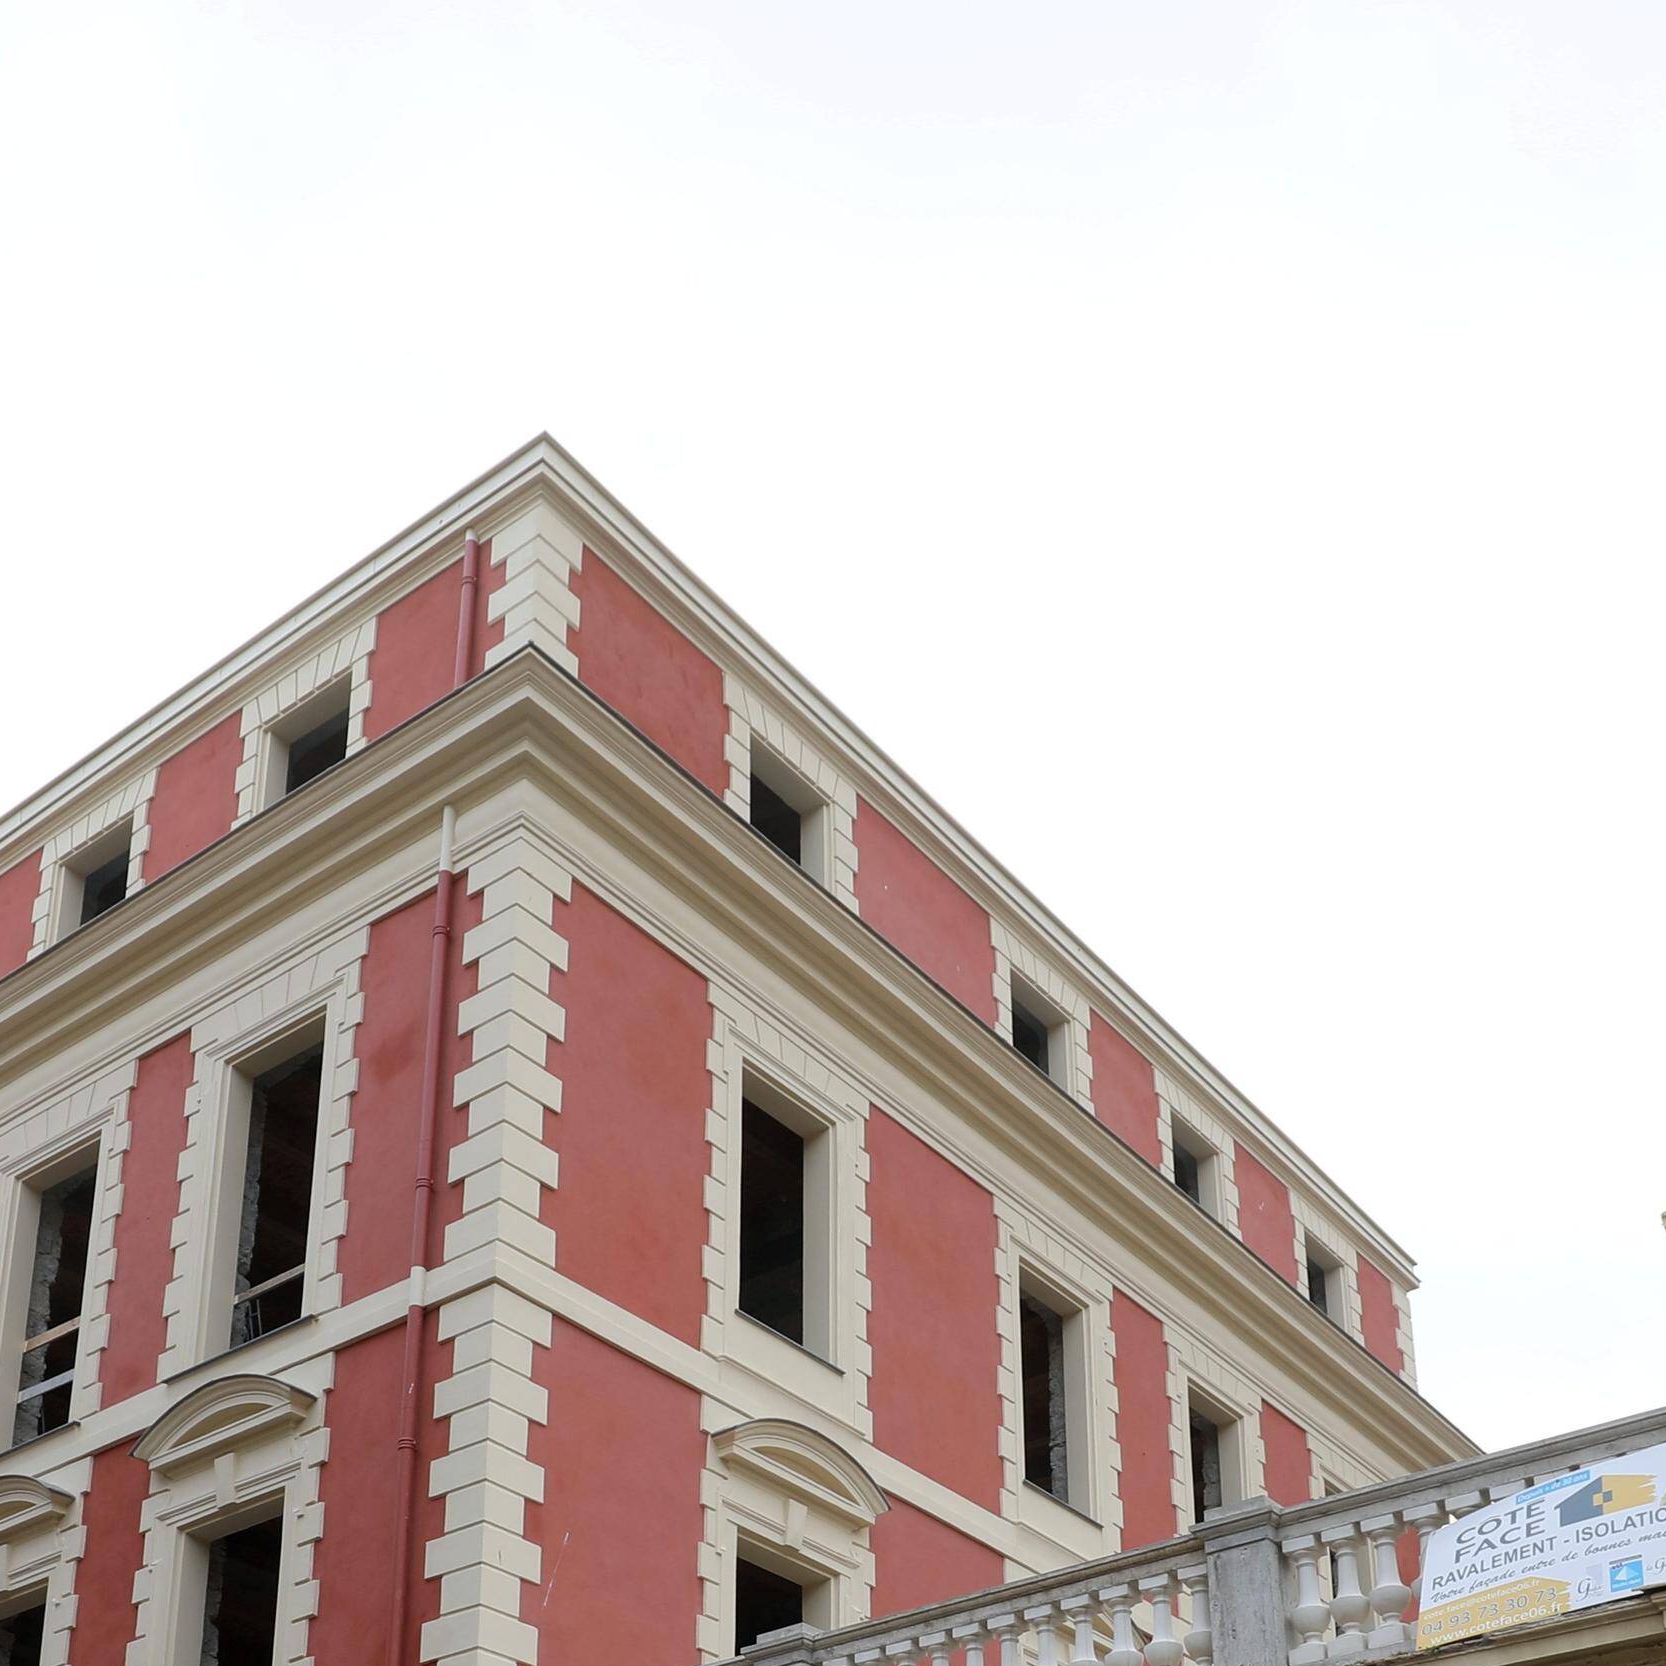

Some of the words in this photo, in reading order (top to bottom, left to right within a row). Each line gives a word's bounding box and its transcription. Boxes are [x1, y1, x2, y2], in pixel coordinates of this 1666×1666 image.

[1432, 1536, 1558, 1590] RAVALEMENT
[1454, 1518, 1546, 1564] FACE
[1431, 1586, 1466, 1604] Votre
[1468, 1569, 1516, 1594] façade
[1521, 1558, 1556, 1575] entre
[1561, 1550, 1579, 1562] de
[1584, 1536, 1632, 1556] bonnes
[1421, 1620, 1444, 1637] 04
[1449, 1611, 1471, 1628] 93
[1478, 1604, 1499, 1620] 73
[1505, 1595, 1528, 1612] 30
[1535, 1587, 1558, 1603] 73
[1430, 1600, 1563, 1646] www.coteface06.fr
